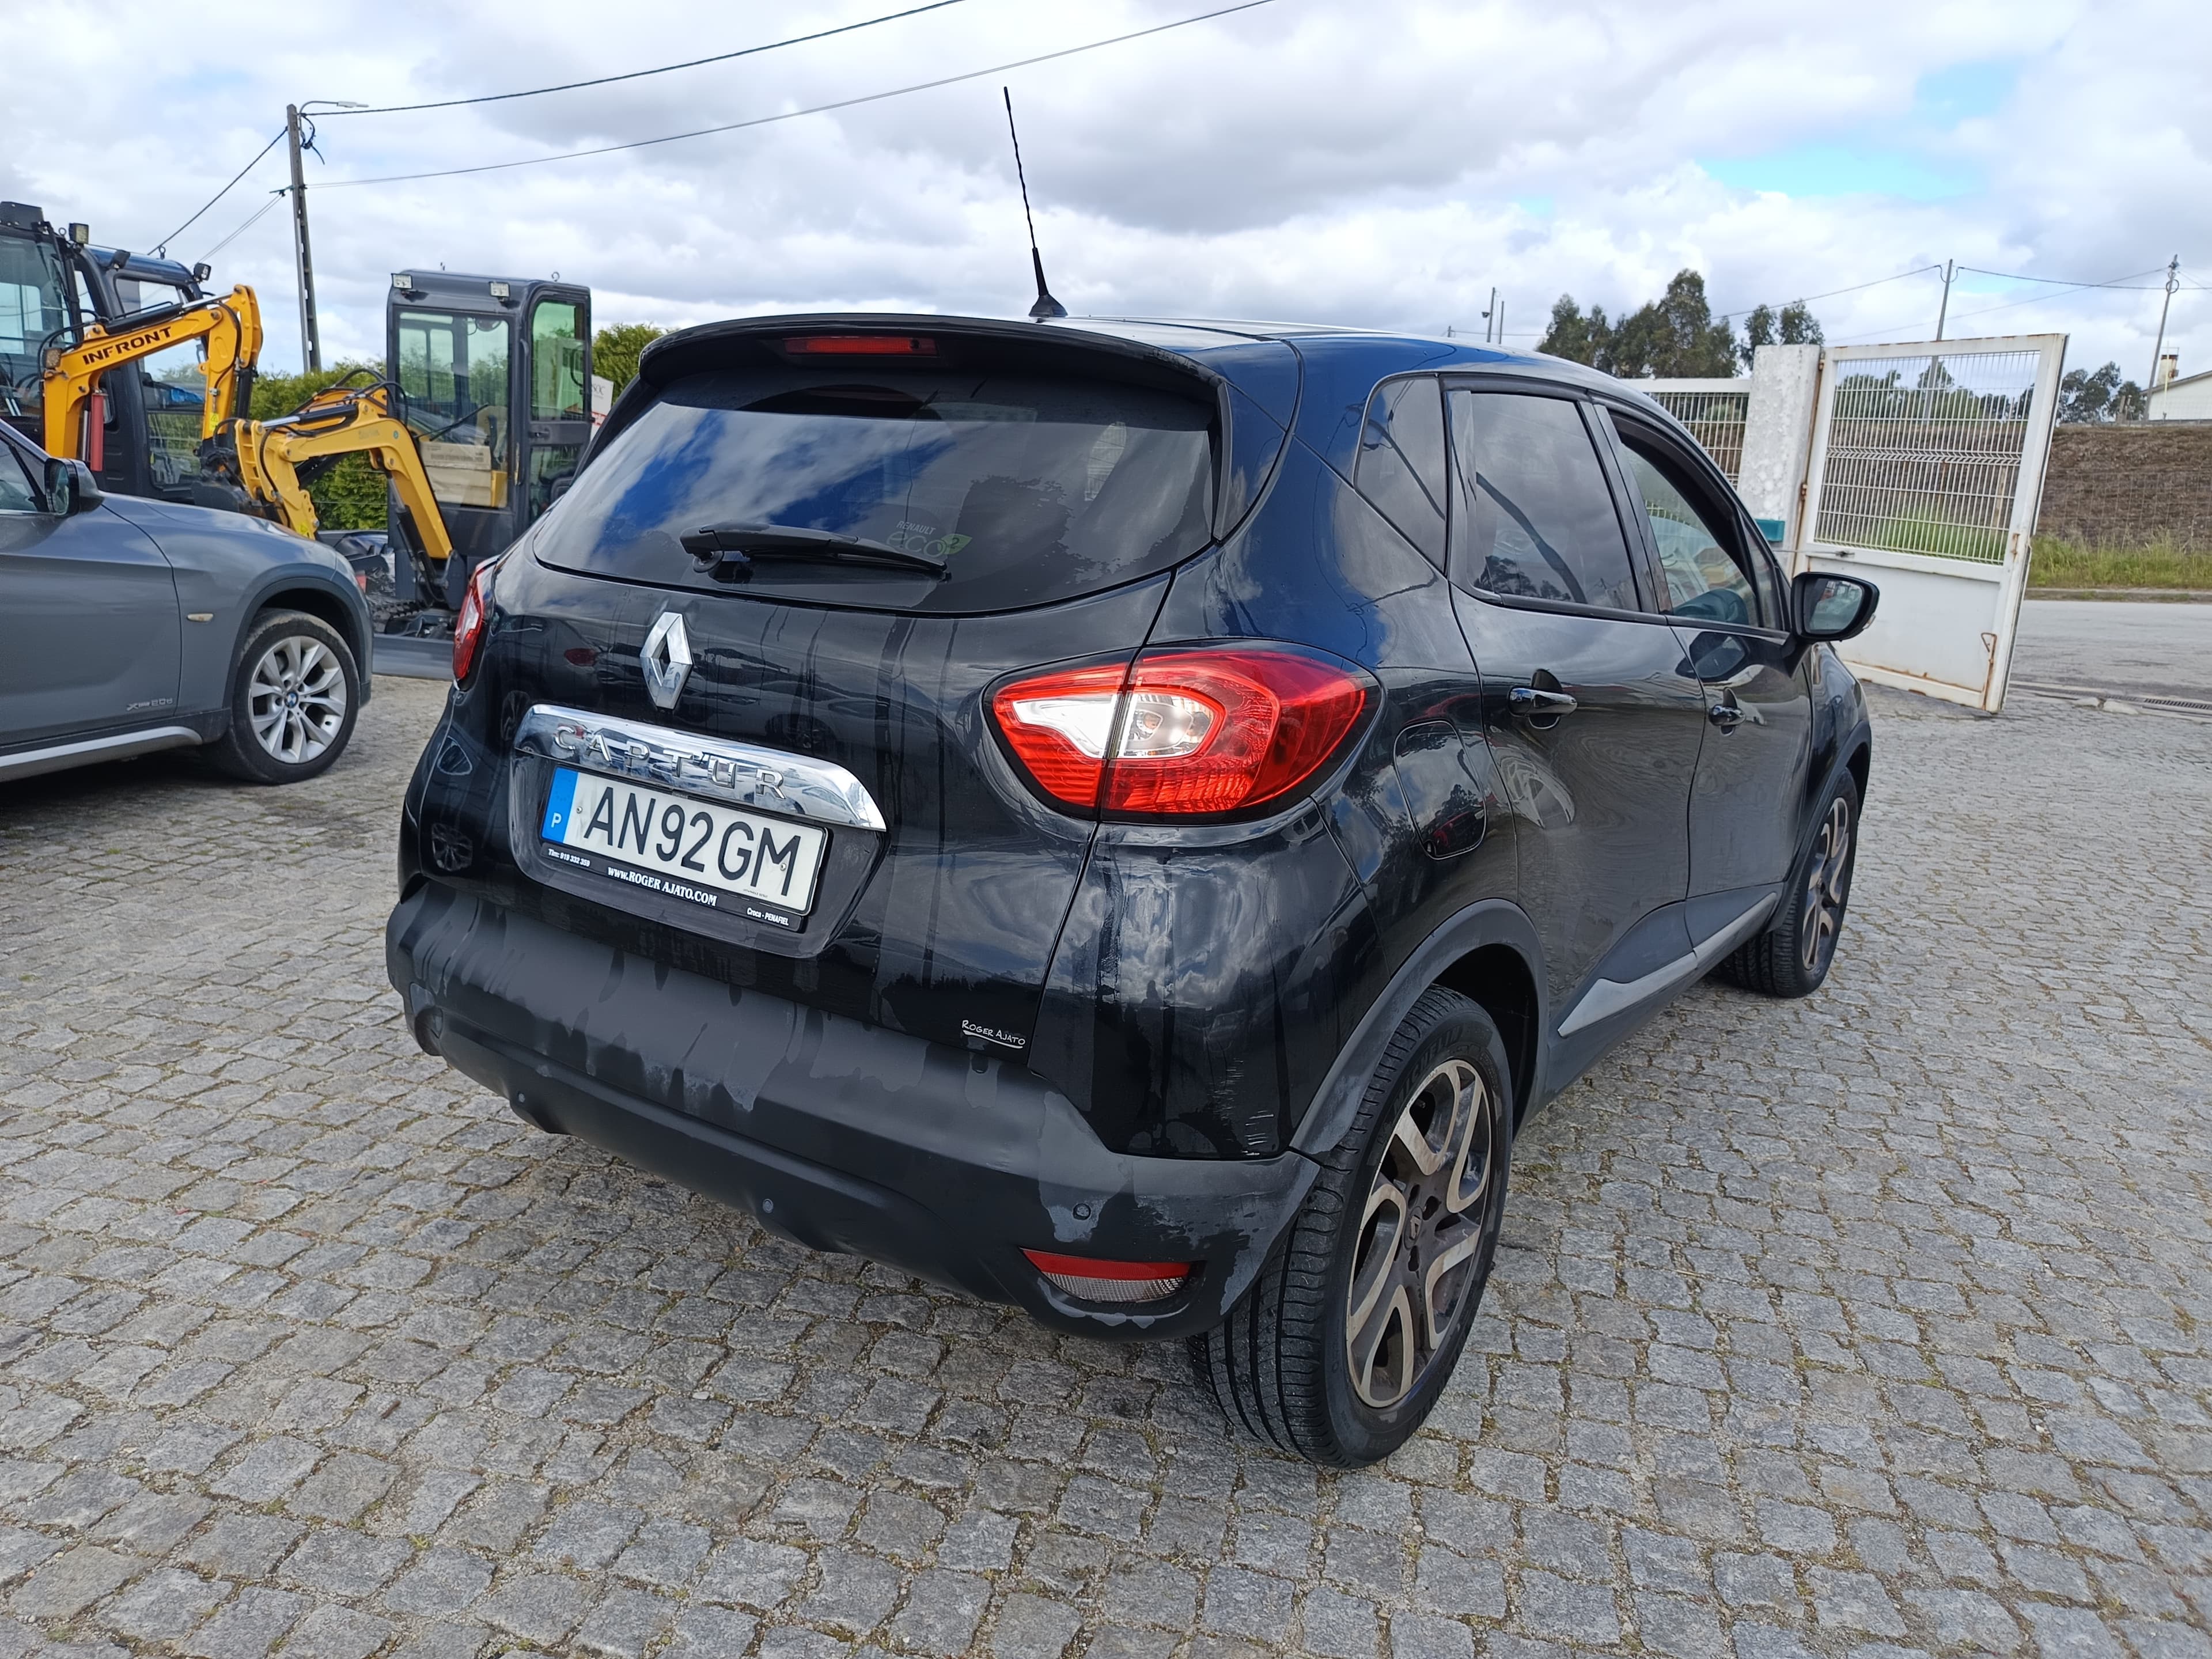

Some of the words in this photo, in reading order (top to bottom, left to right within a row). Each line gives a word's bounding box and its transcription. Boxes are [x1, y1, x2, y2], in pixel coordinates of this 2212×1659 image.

[82, 327, 171, 365] INFRONT
[896, 521, 936, 535] RENAULT
[554, 725, 786, 800] CAPTUR
[551, 812, 562, 828] P
[584, 787, 801, 896] AN92GM
[560, 852, 570, 861] 919
[608, 867, 661, 889] www.ROGER
[662, 882, 718, 906] AJATO.COM
[747, 907, 762, 918] Croca
[764, 912, 789, 926] PENAFIEL
[962, 1020, 994, 1037] ROGER
[995, 1029, 1025, 1045] AJATO
